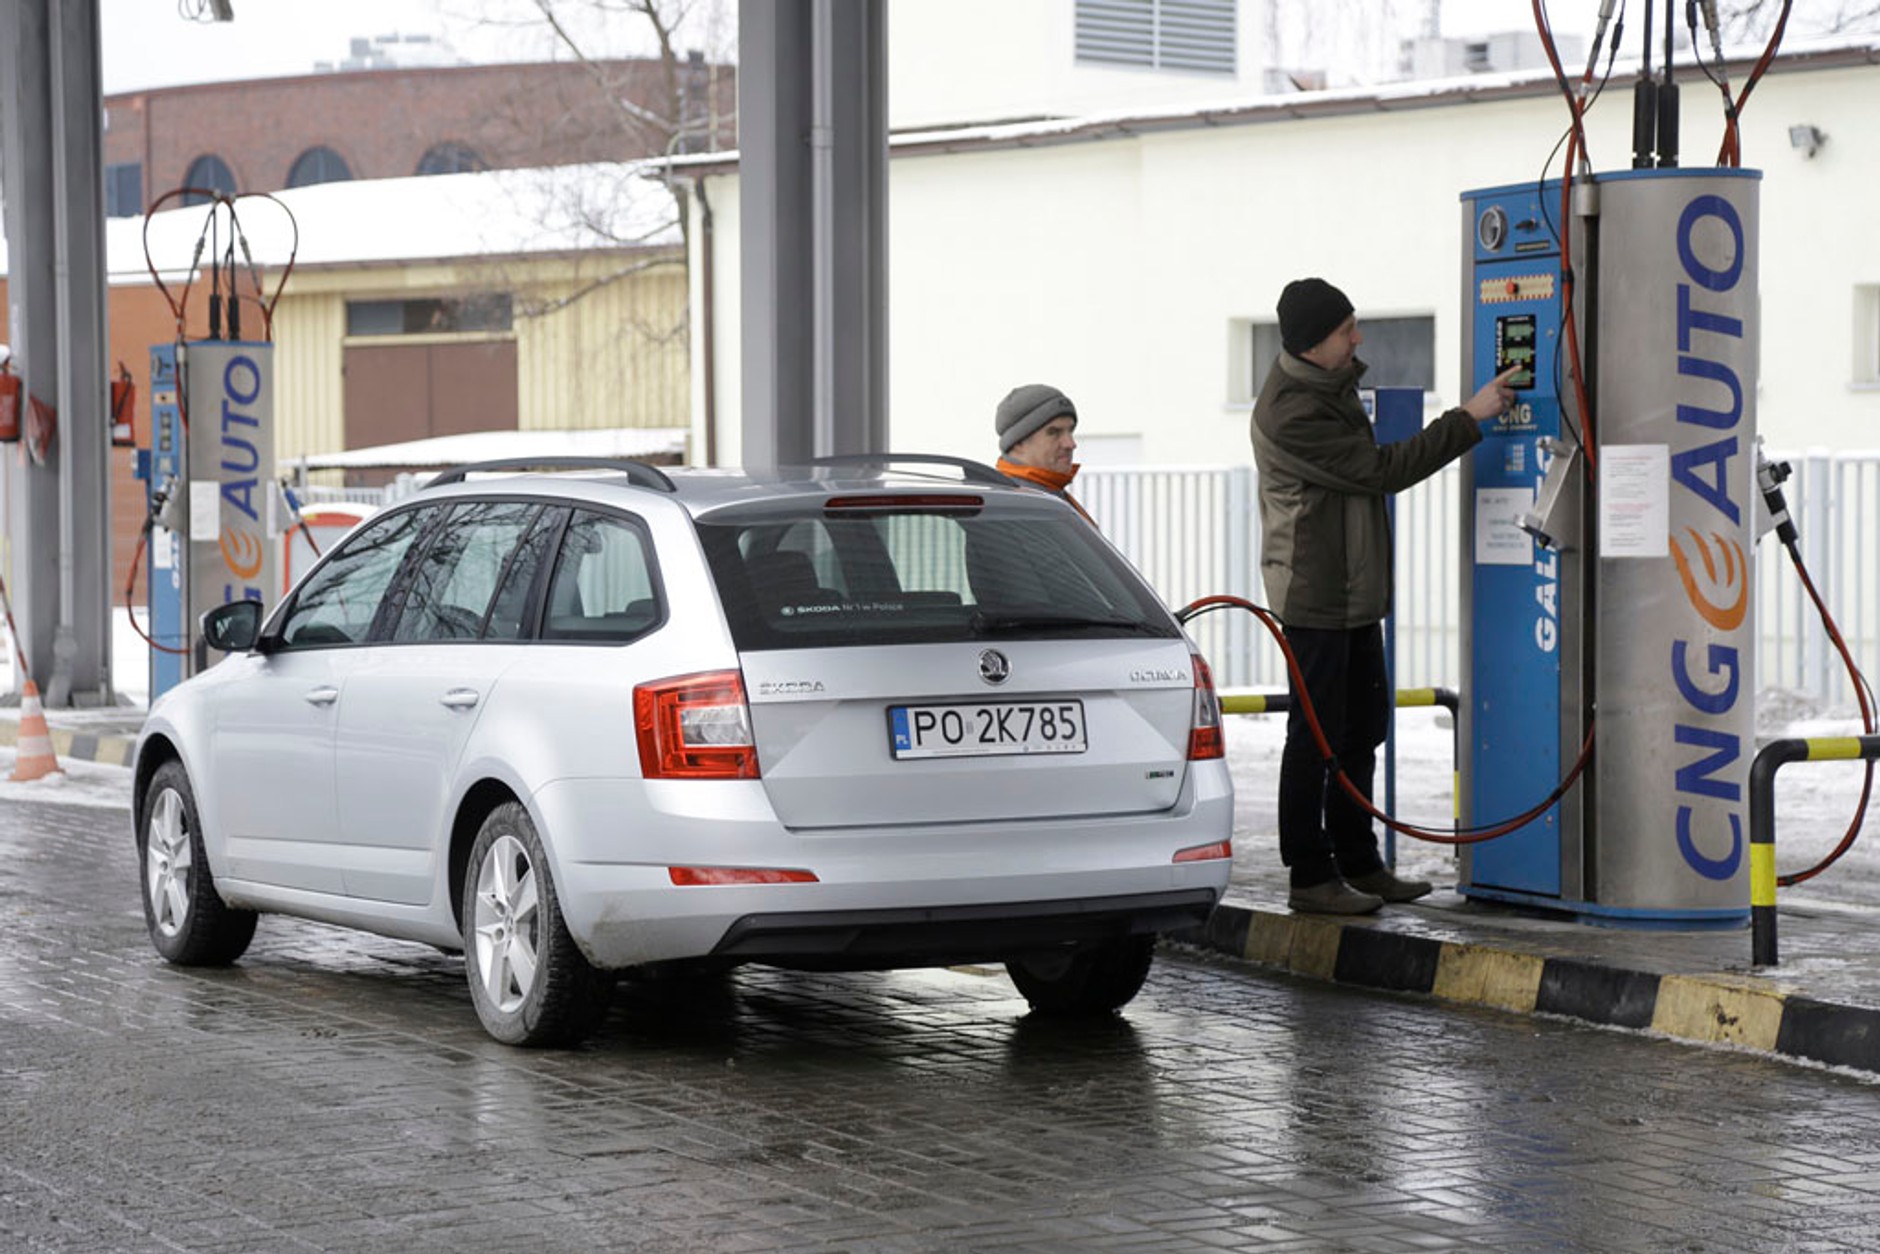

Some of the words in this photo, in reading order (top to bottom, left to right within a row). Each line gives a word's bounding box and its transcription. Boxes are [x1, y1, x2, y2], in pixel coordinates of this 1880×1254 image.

[221, 355, 261, 522] AUTO
[1671, 194, 1745, 527] AUTO
[914, 709, 964, 746] PO
[976, 706, 1077, 743] 2K785
[1671, 639, 1742, 881] CNG
